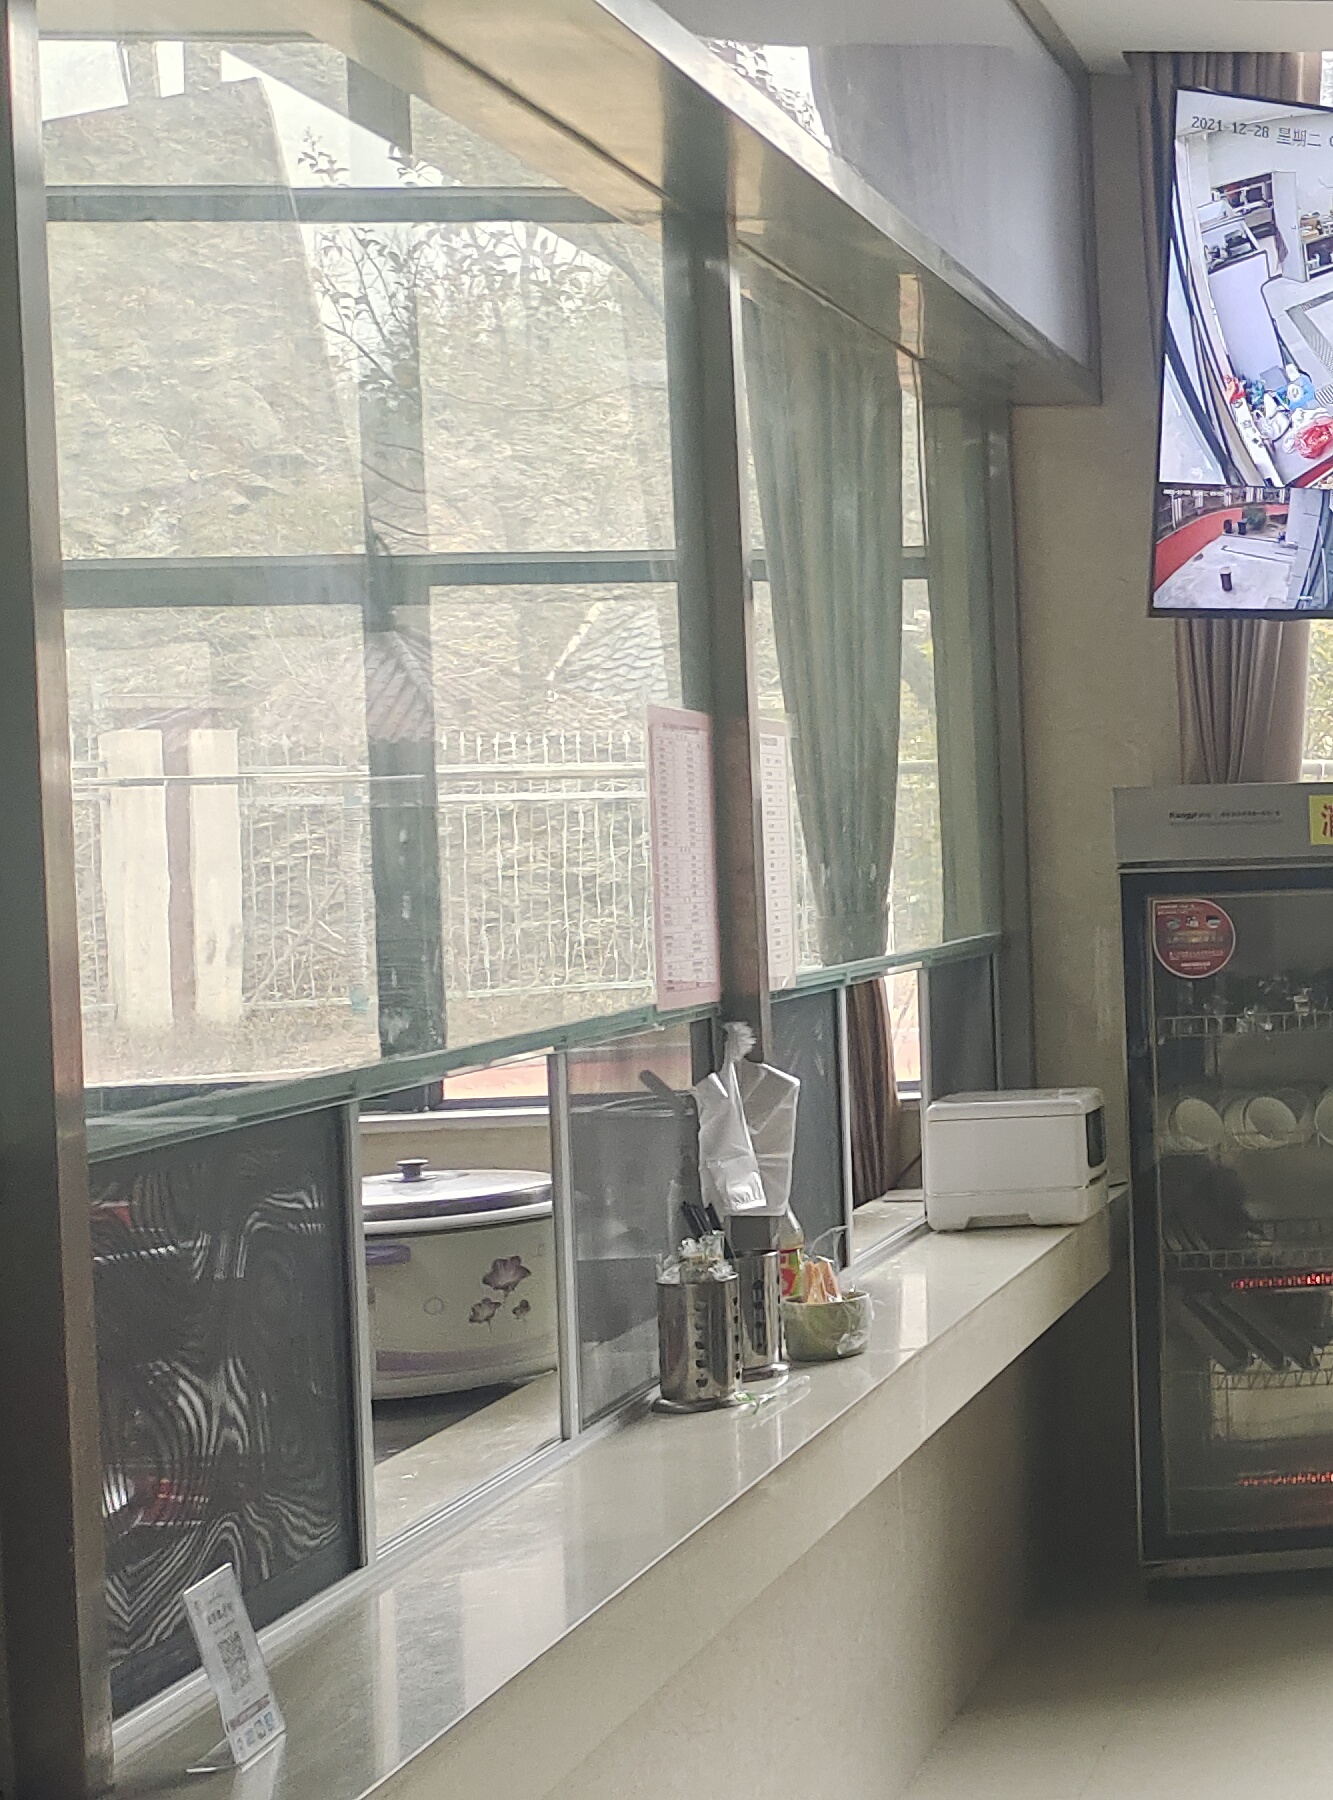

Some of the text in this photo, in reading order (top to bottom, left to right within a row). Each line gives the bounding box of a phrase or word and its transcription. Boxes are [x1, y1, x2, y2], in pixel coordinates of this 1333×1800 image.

[1191, 116, 1270, 139] 2021-12-28
[1276, 127, 1322, 147] 星期二
